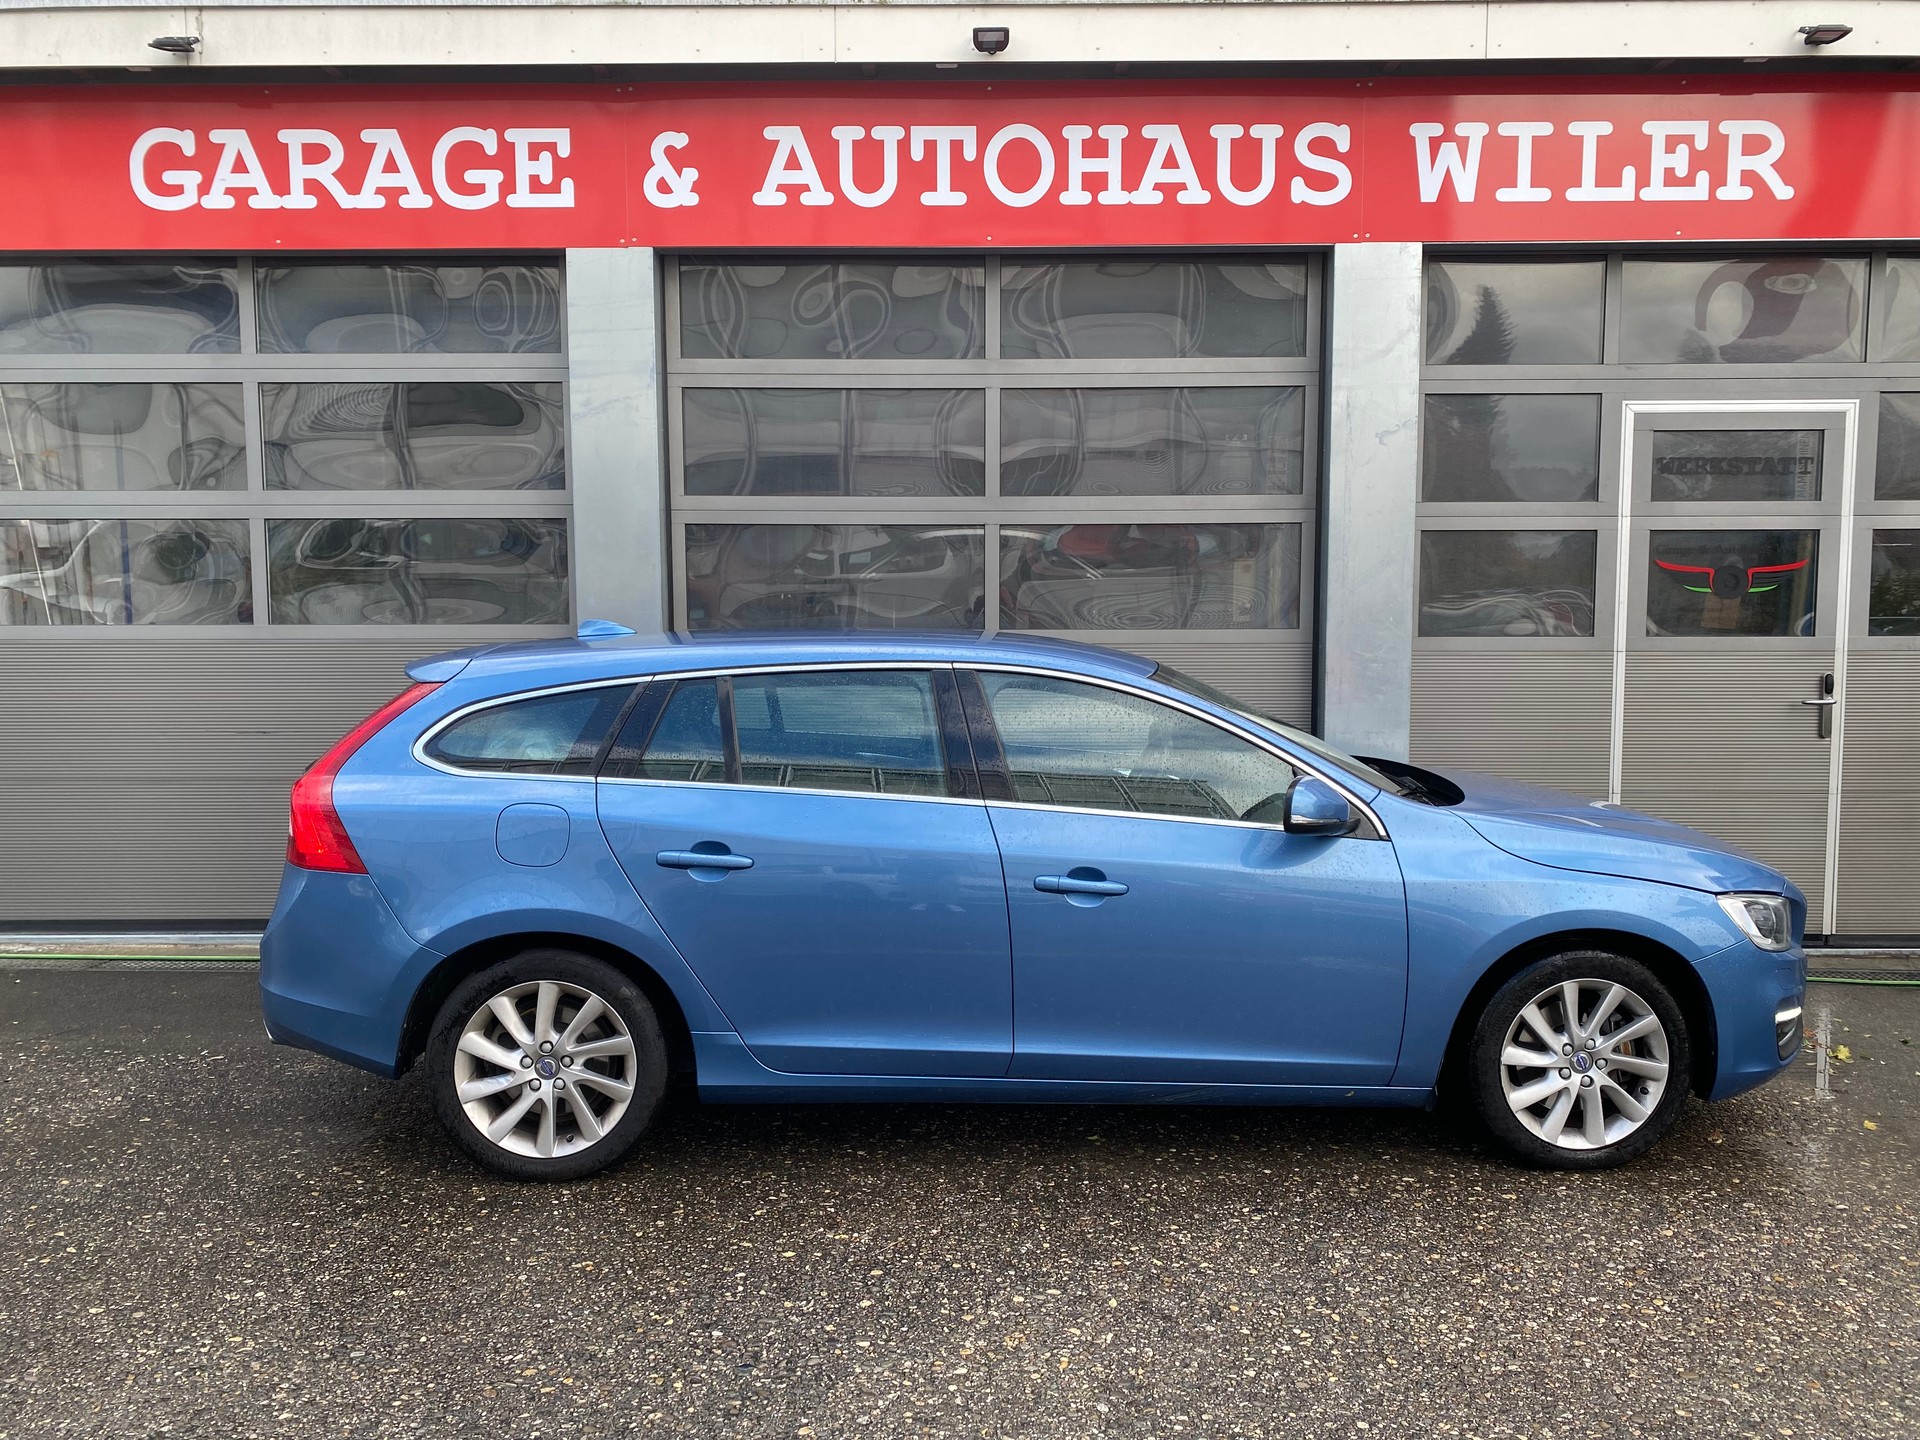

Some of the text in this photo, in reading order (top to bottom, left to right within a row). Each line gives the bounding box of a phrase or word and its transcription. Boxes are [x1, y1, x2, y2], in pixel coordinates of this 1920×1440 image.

[129, 119, 1795, 212] GARAGE & AUTOHAUS WILER
[1655, 456, 1815, 475] WERKSTATT
